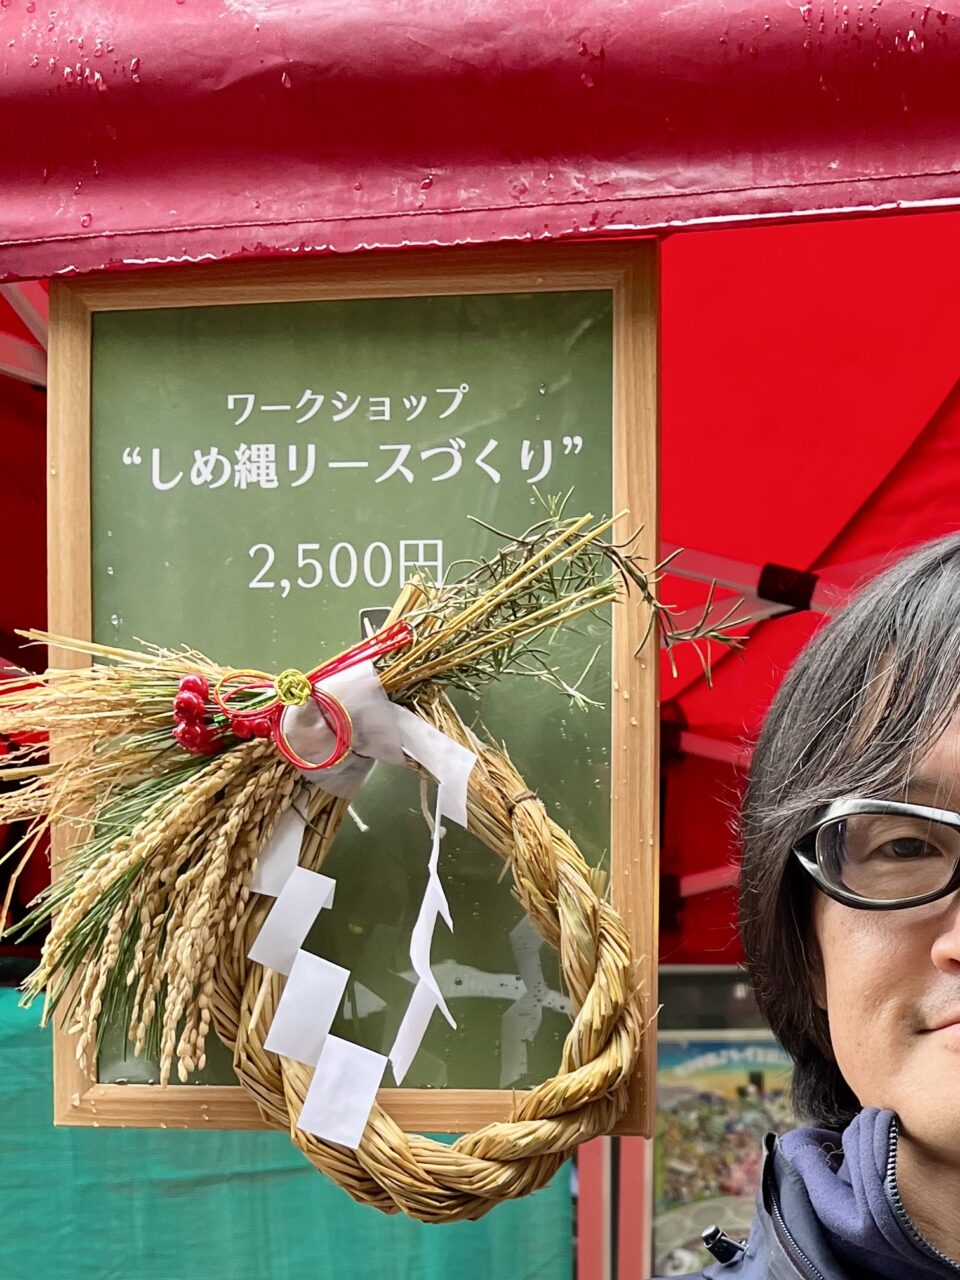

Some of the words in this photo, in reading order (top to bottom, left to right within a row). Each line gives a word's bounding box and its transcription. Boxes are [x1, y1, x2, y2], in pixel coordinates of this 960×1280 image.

[226, 382, 470, 425] ワークショップ
[247, 538, 444, 598] 2,500円
